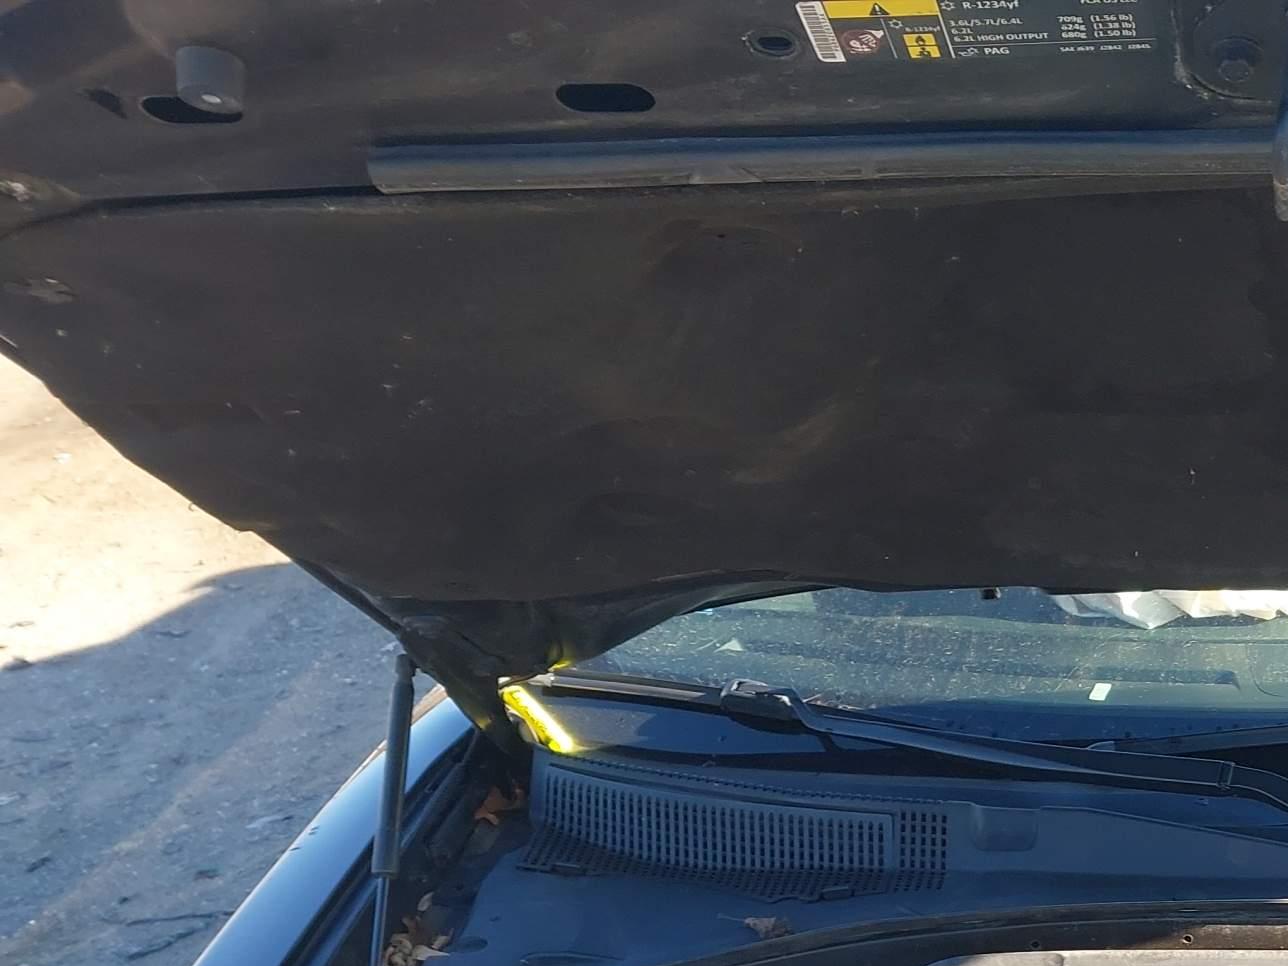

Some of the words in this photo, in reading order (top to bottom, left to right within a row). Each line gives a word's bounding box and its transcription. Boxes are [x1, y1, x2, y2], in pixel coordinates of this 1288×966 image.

[962, 0, 1019, 9] R-1234yf
[1005, 32, 1049, 40] OUTPUT
[983, 46, 1010, 55] PAG
